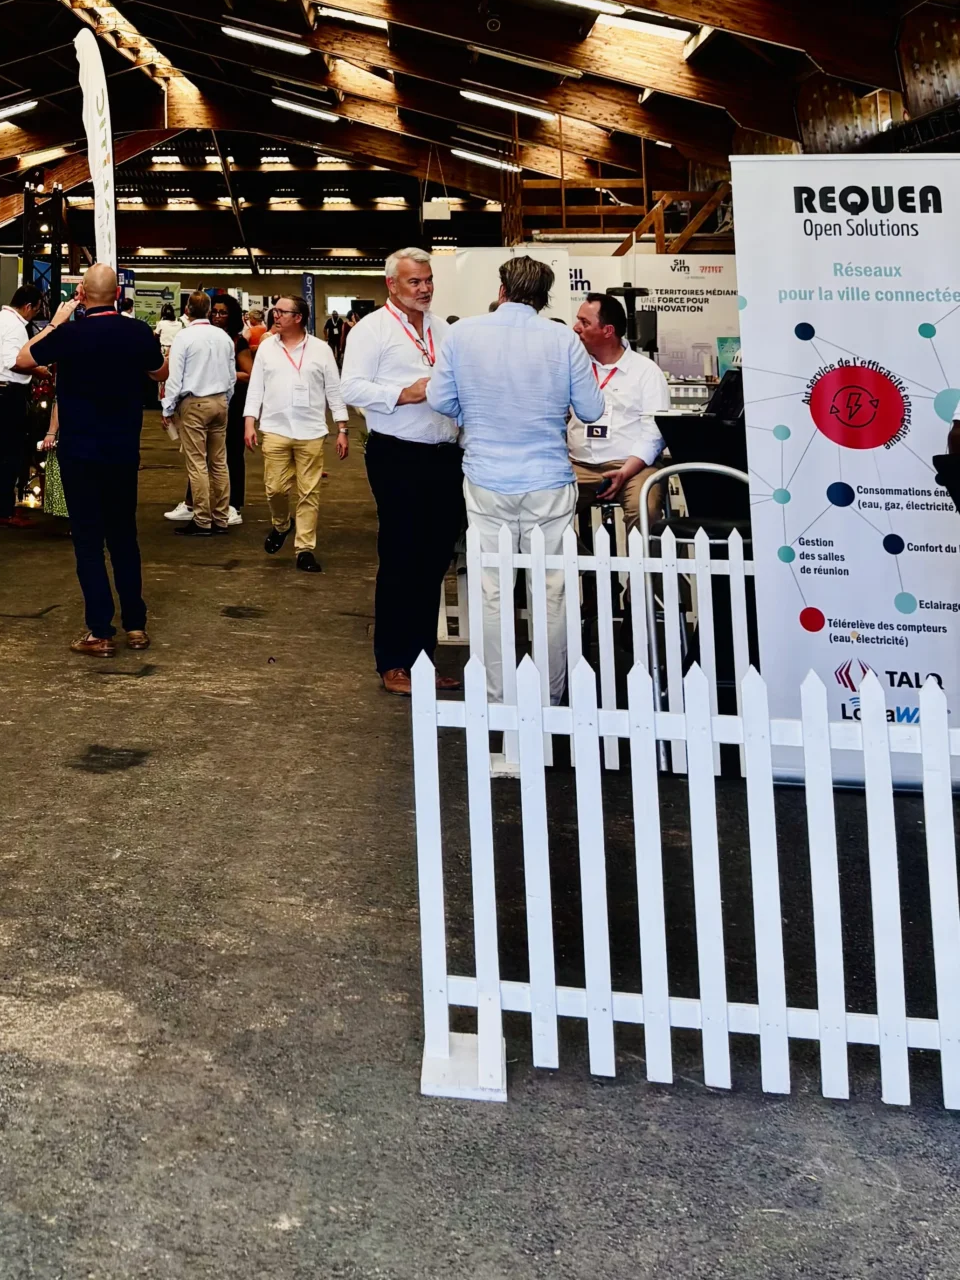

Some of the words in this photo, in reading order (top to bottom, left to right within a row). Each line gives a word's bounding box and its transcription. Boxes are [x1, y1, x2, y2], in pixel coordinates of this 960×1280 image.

[793, 185, 943, 216] REQUEA
[803, 219, 842, 240] Open
[846, 218, 919, 237] Solutions
[833, 262, 902, 277] Réseaux
[654, 288, 704, 296] TERRITOIRES
[778, 288, 814, 303] pour
[818, 287, 833, 300] la
[837, 287, 870, 301] ville
[874, 287, 960, 302] connectée
[657, 296, 685, 304] FORCE
[641, 304, 703, 312] L'INNOVATION
[837, 357, 851, 368] de
[805, 363, 836, 391] service
[852, 356, 910, 393] l'efficacité
[801, 391, 811, 406] Au
[856, 485, 932, 497] Consommations
[857, 499, 883, 510] (eau,
[884, 502, 904, 511] gaz,
[798, 537, 834, 547] Gestion
[907, 543, 943, 553] Confort
[944, 544, 957, 553] du
[799, 552, 816, 561] des
[817, 553, 845, 562] salles
[800, 566, 812, 574] de
[813, 566, 850, 576] réunion
[827, 618, 876, 630] Télérelève
[877, 622, 895, 631] des
[896, 624, 948, 634] compteurs
[829, 633, 854, 644] (eau,
[856, 635, 909, 647] électricité)
